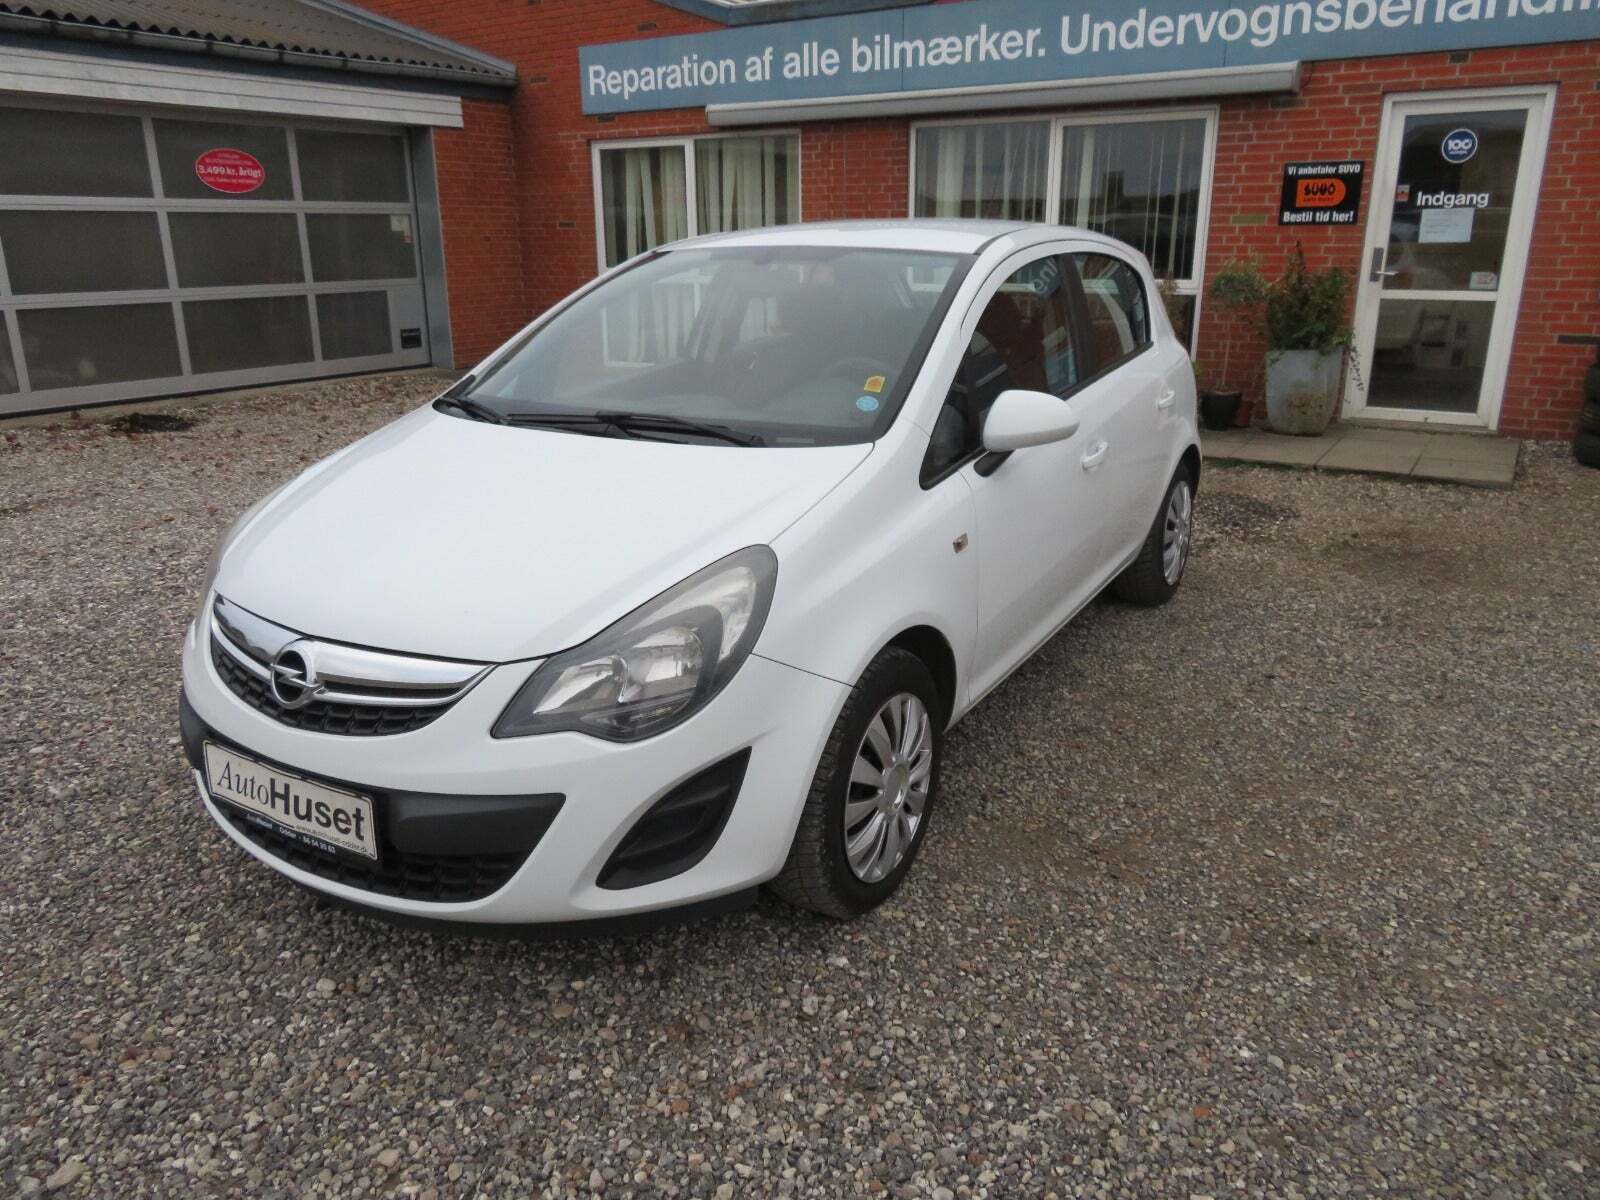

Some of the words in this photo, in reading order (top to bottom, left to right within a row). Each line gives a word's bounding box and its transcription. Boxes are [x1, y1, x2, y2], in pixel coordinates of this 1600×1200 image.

[588, 54, 737, 100] Reparation
[744, 46, 774, 82] af
[782, 41, 841, 79] alle
[851, 23, 1046, 73] bilmærker.
[1287, 165, 1297, 176] Vi
[1298, 165, 1337, 175] anbefaler
[1338, 163, 1361, 174] SUVO
[1416, 190, 1490, 209] Indgang
[1282, 211, 1313, 222] Bestil
[1315, 211, 1330, 222] tid
[1332, 210, 1354, 222] her!
[217, 760, 366, 841] AutoHuset
